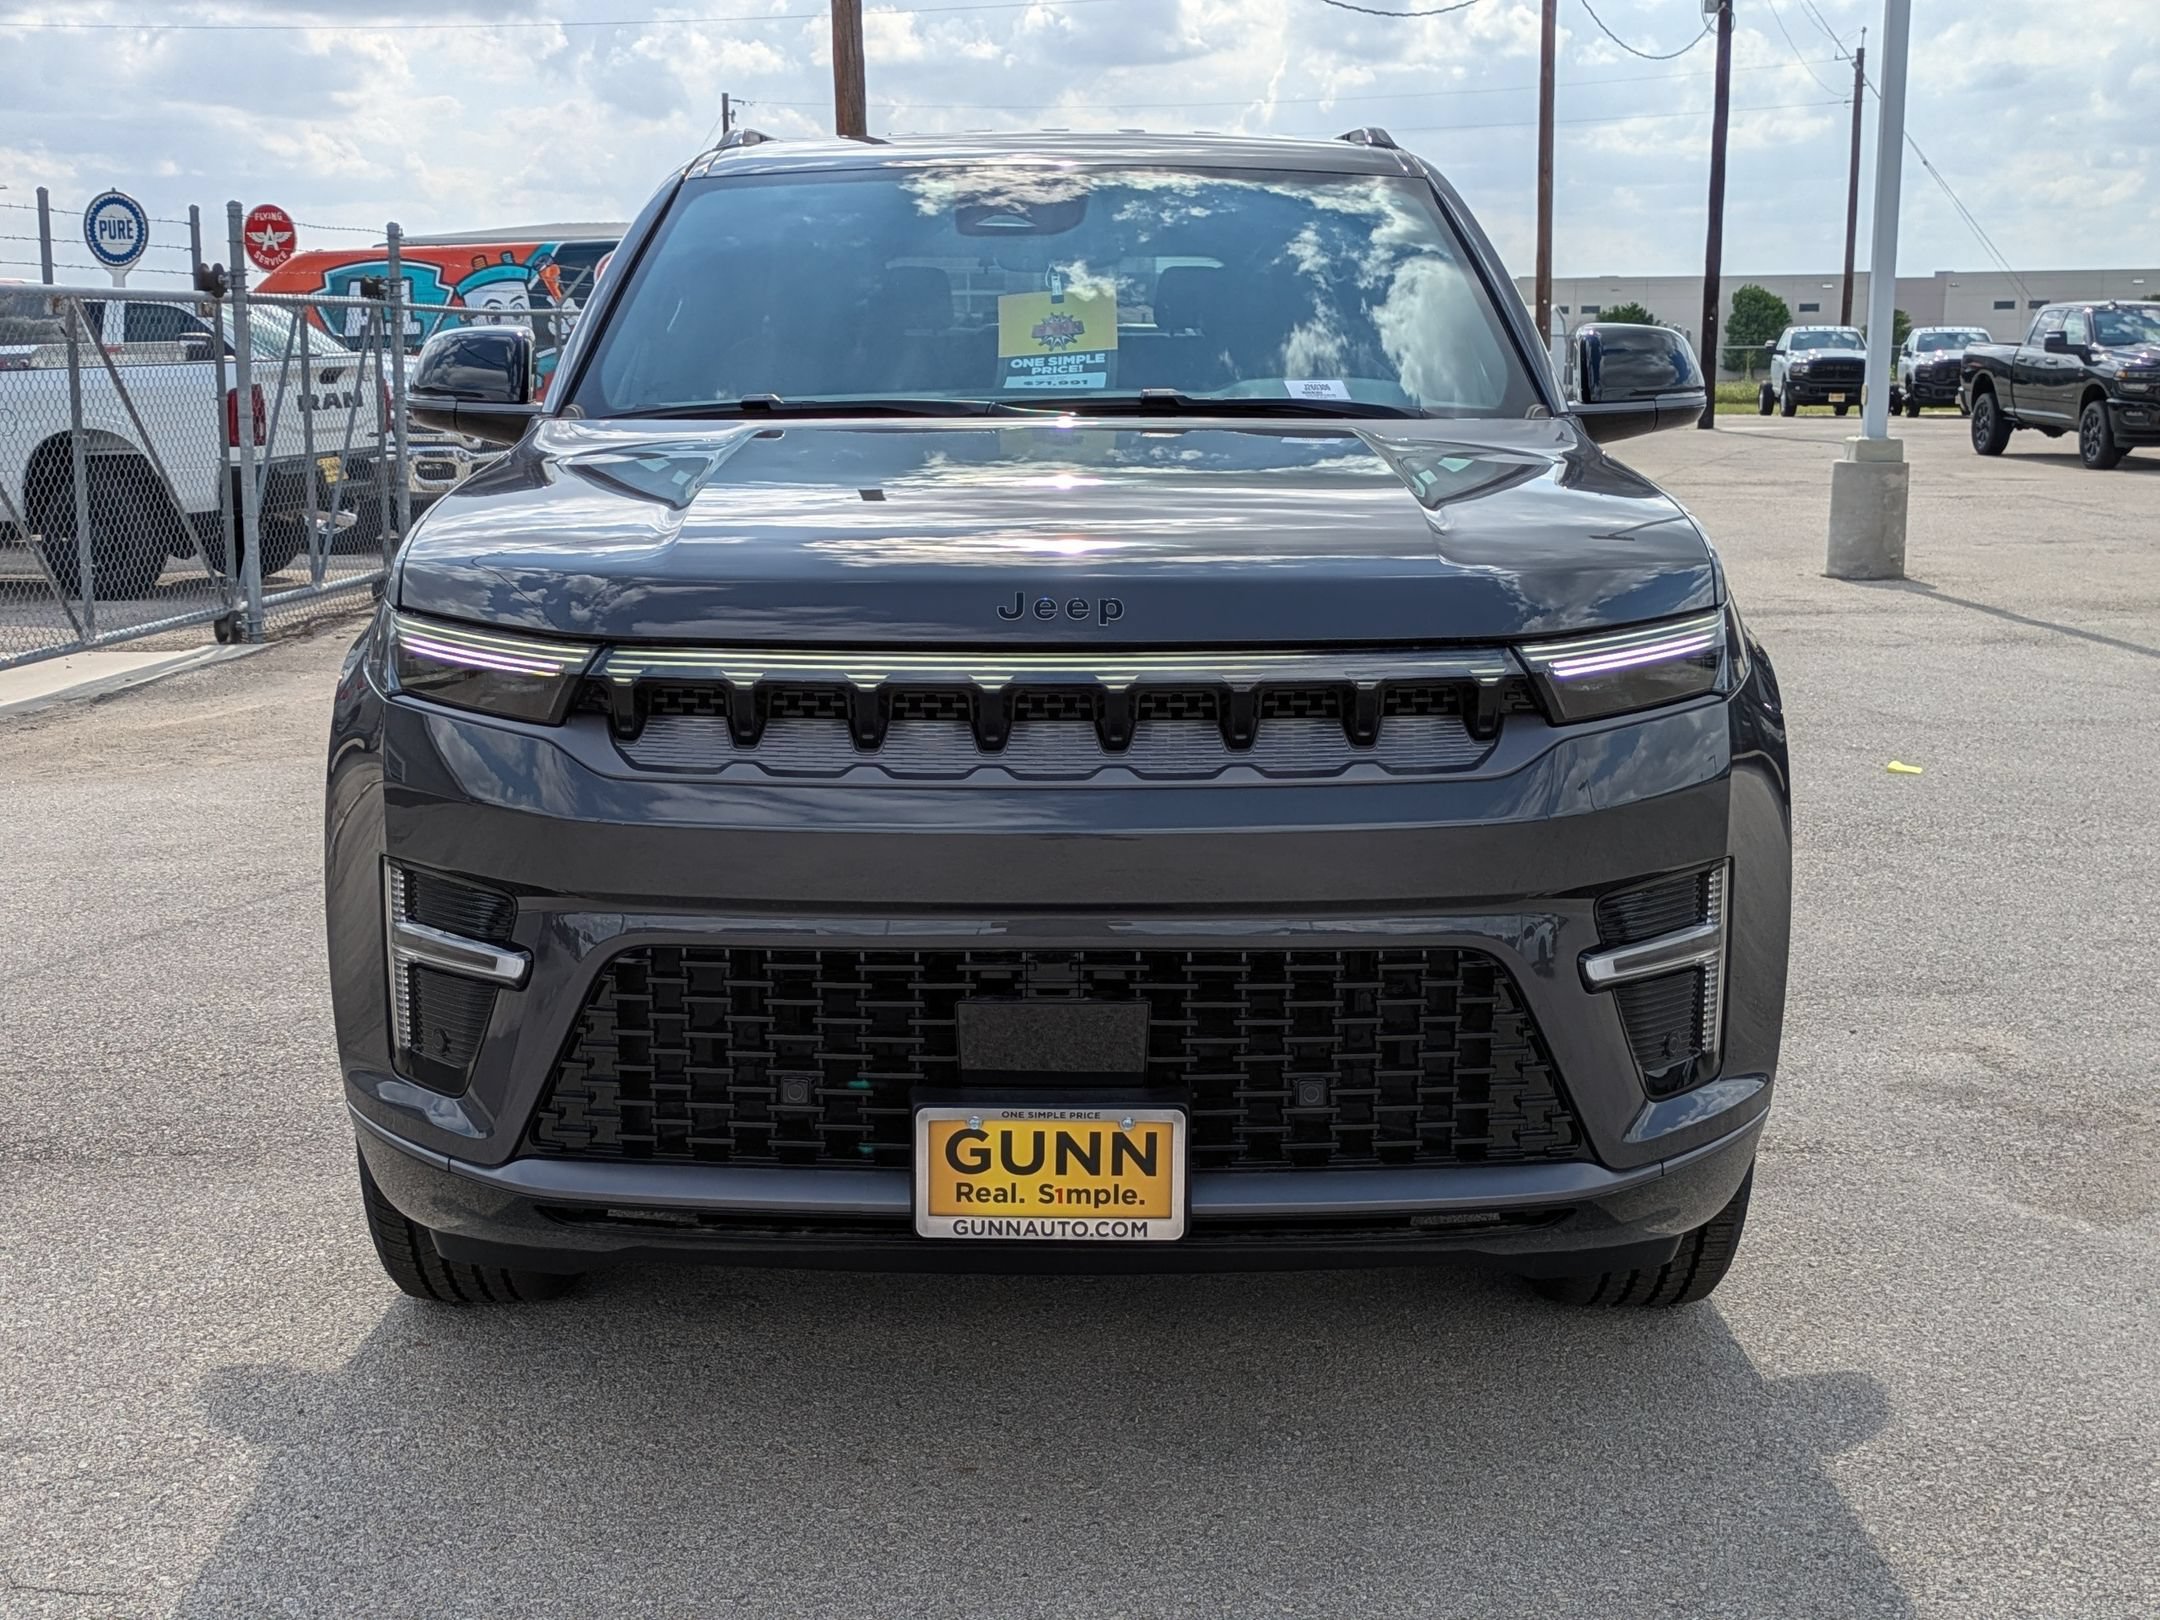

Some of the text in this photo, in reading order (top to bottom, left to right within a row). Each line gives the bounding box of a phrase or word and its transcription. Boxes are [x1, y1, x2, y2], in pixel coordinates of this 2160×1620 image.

[254, 211, 284, 221] FLYING
[100, 219, 134, 240] PURE
[254, 250, 288, 266] SERVICE
[1010, 353, 1106, 369] ONE SIMPLE
[1031, 364, 1084, 375] PRICE!
[297, 390, 364, 412] RAM
[996, 591, 1125, 627] Jeep
[1001, 1110, 1101, 1120] ONE SIMPLE PRICE
[945, 1128, 1157, 1176] GUNN
[955, 1182, 1025, 1204] Real.
[952, 1219, 1149, 1239] GUNNAUTO.COM
